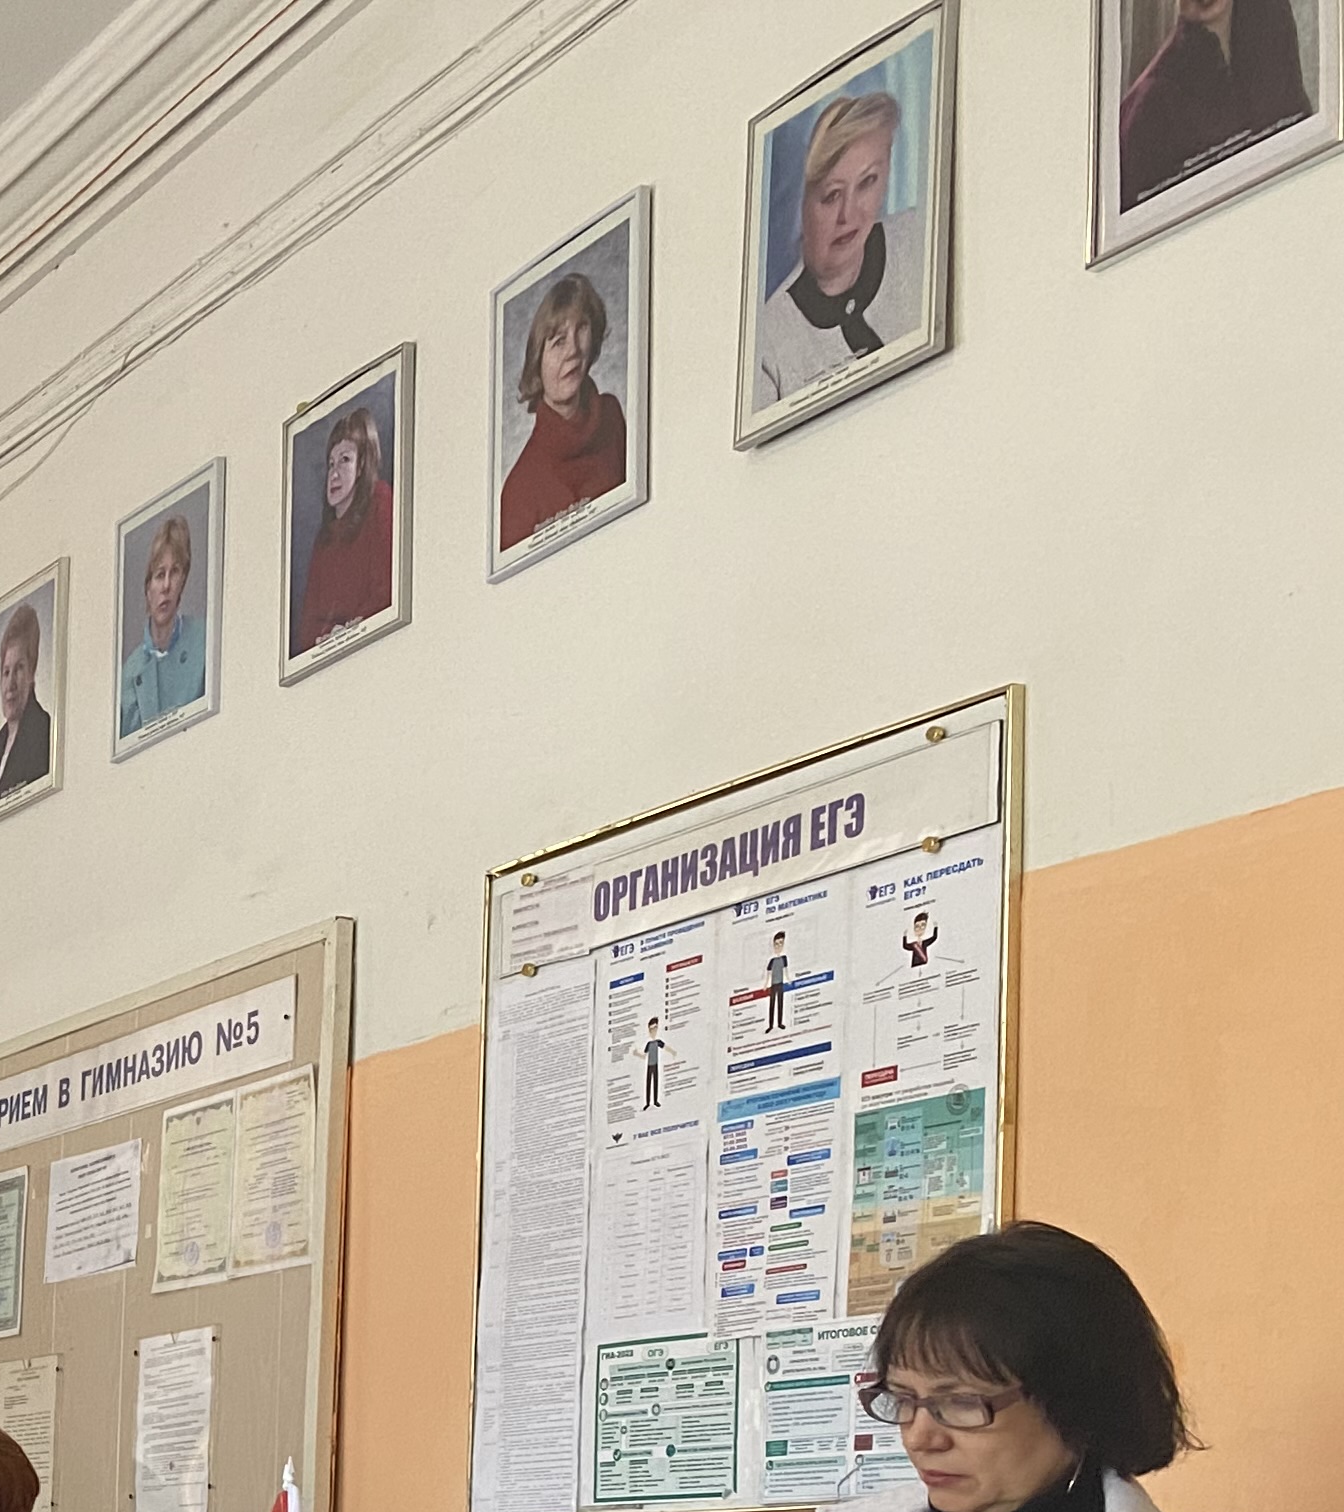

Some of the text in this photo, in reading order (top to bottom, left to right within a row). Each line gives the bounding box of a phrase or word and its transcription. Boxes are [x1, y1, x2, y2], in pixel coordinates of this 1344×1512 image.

[593, 813, 802, 922] ОРГАНИЗАЦИЯ
[809, 793, 866, 851] ЕГЭ
[903, 857, 984, 888] КАК ПЕРЕСДАТЬ
[878, 883, 896, 898] ЕГЭ
[903, 886, 927, 901] ЕГЭ?
[743, 901, 760, 915] ЕГЭ
[620, 943, 635, 956] ЕГЭ
[58, 1077, 70, 1109] В
[81, 1030, 203, 1101] ГИМНАЗИЮ
[818, 1326, 868, 1340] ИТОГОВОЕ
[648, 1349, 664, 1357] ОГЭ
[714, 1341, 728, 1350] ЕГЭ
